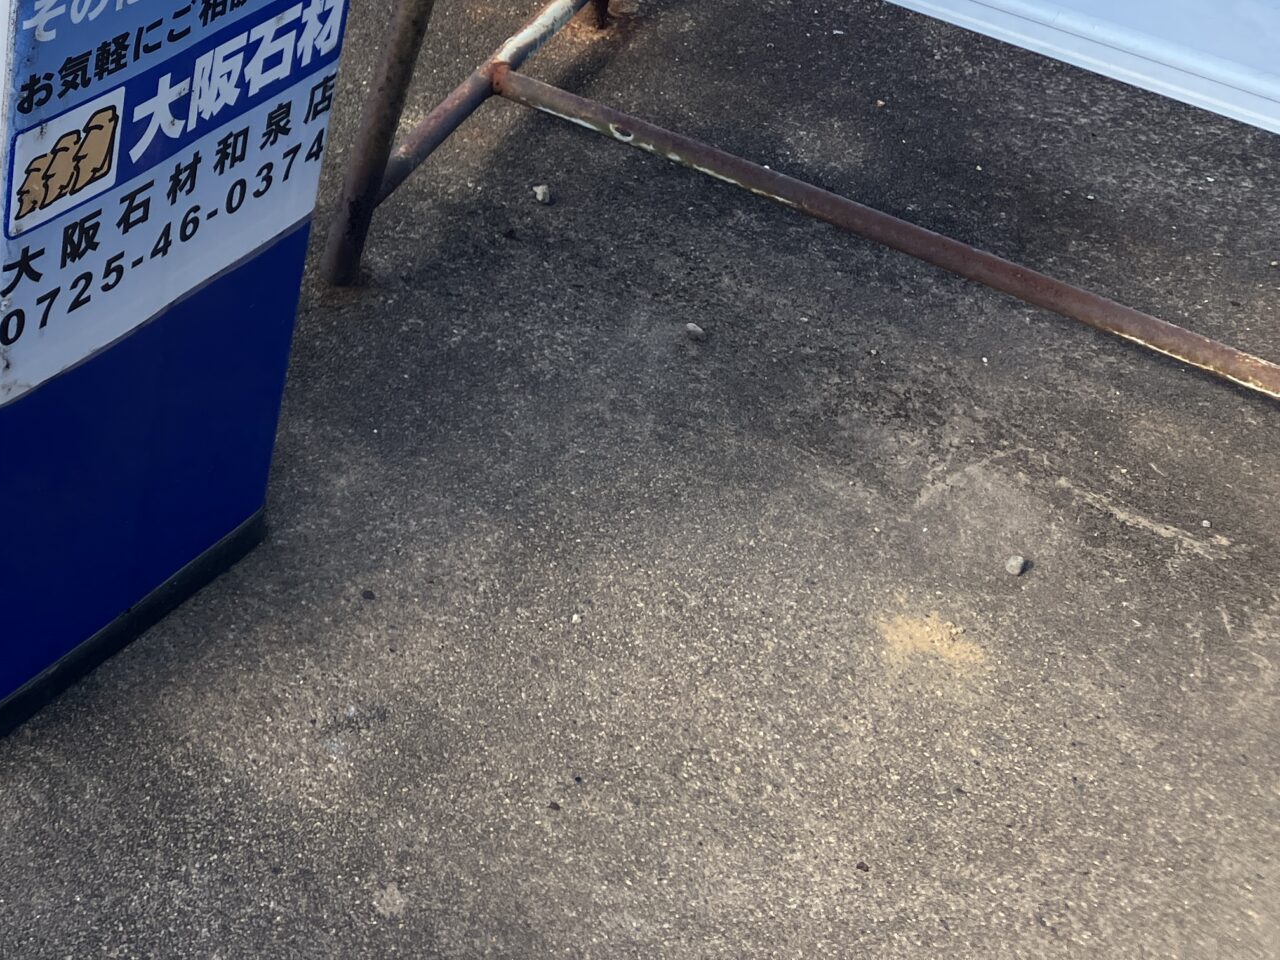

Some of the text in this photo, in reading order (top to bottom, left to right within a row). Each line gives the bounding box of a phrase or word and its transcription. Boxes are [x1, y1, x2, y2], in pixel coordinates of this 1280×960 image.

[0, 72, 337, 298] 大阪石材和泉店
[0, 128, 325, 346] 0725-46-0374
